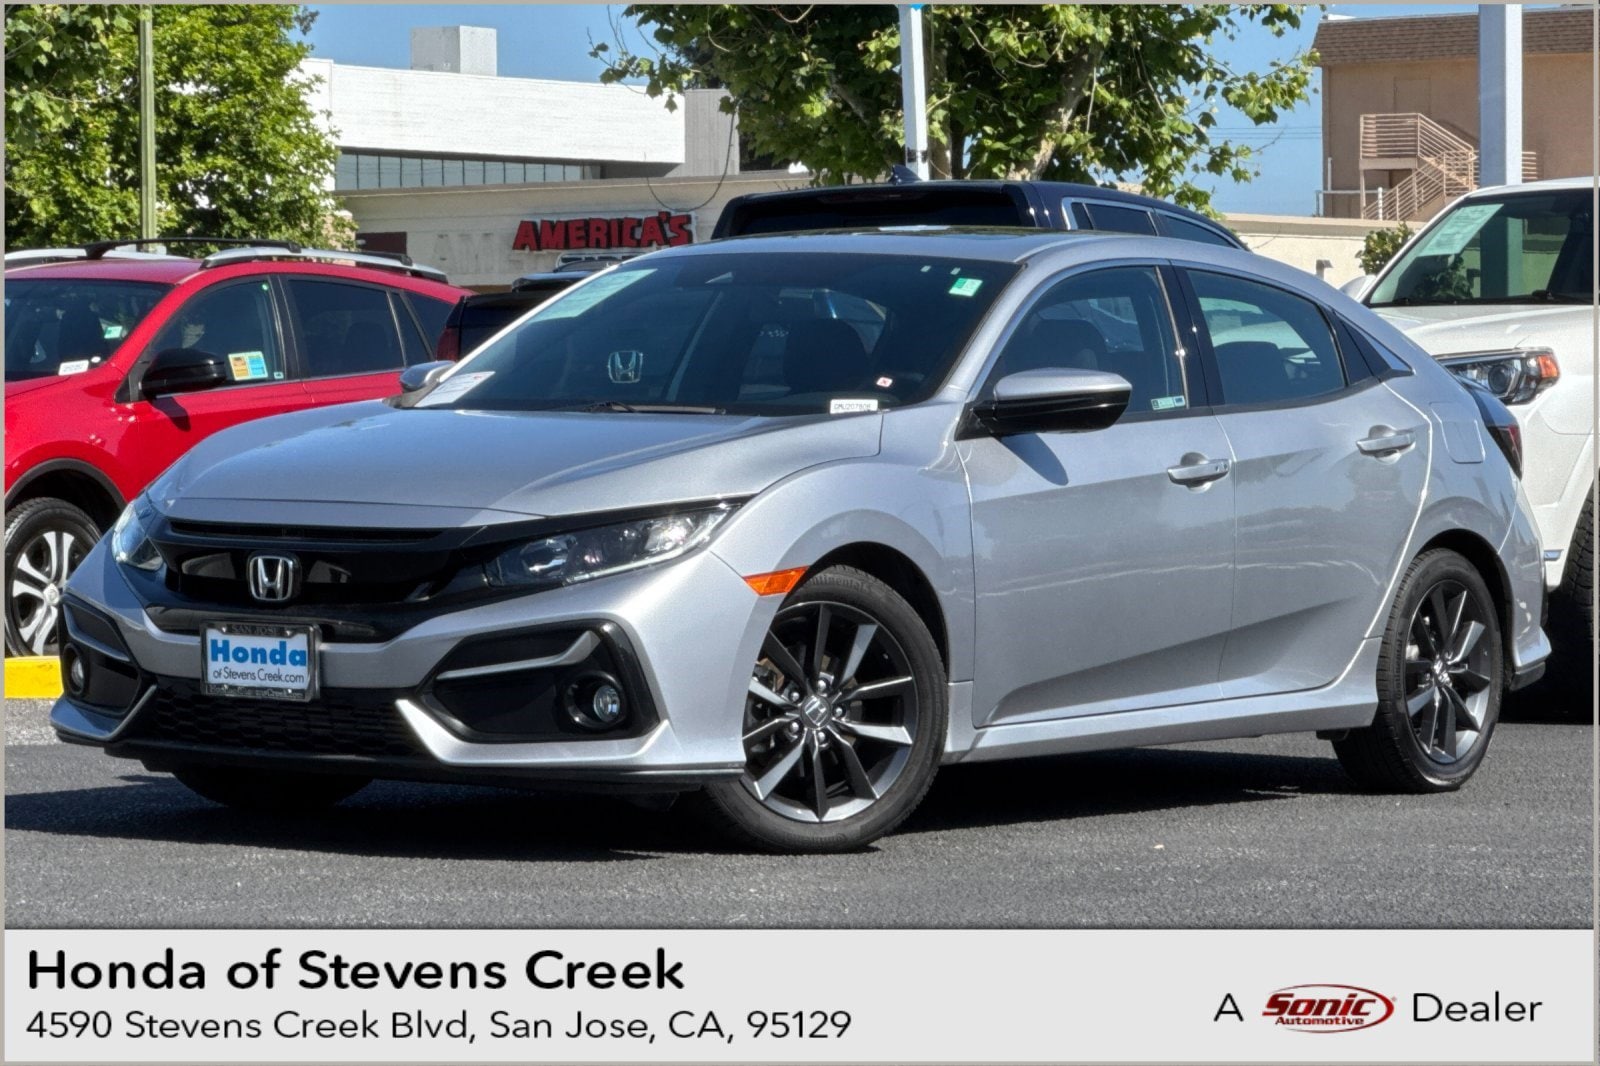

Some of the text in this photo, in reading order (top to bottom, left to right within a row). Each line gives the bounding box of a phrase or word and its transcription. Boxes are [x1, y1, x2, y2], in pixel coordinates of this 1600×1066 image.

[512, 211, 693, 251] AMERICA'S
[210, 639, 306, 666] Honda
[213, 667, 222, 679] of
[223, 666, 257, 680] Stevens
